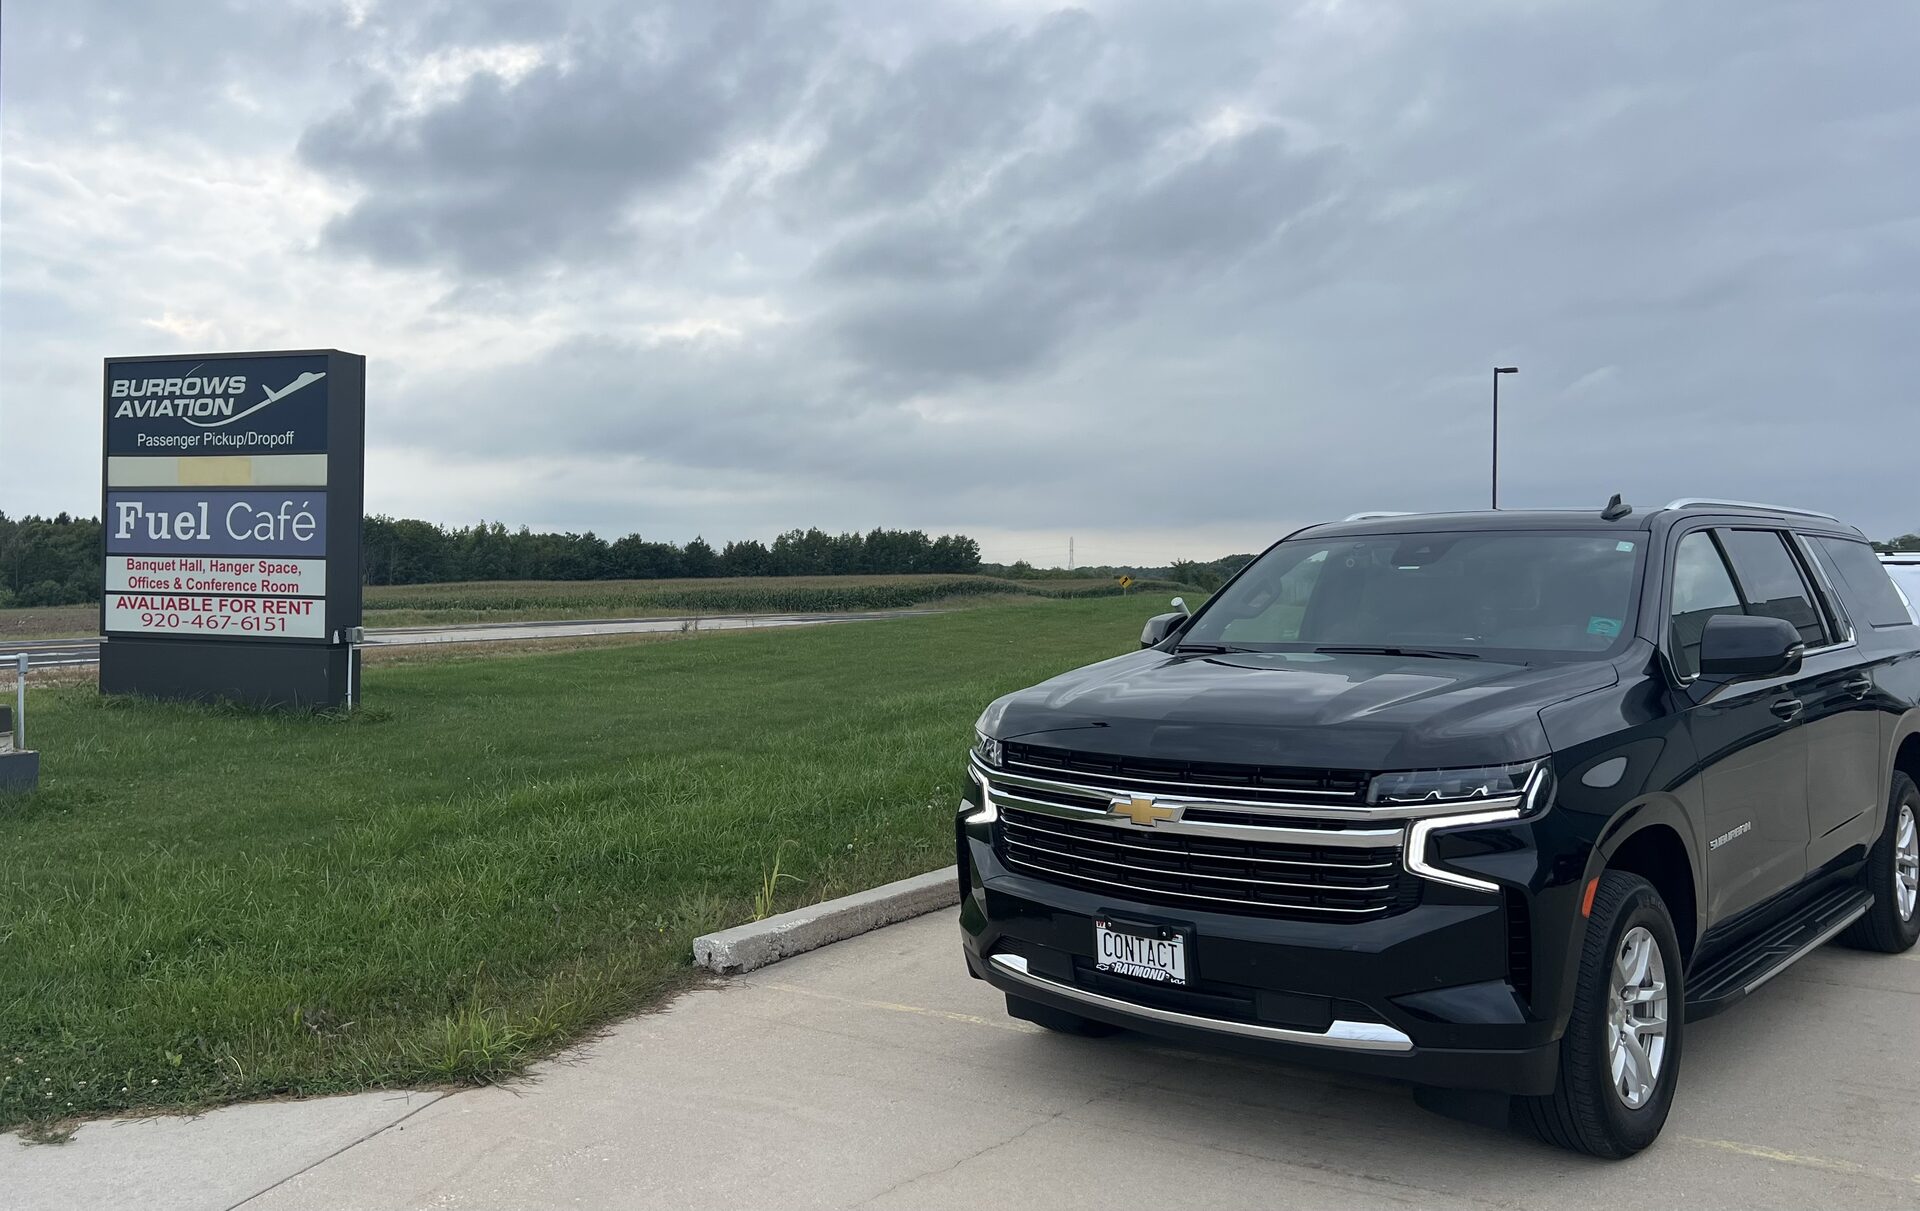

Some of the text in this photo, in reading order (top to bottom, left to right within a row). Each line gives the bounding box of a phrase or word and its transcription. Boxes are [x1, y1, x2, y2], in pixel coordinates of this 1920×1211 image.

[111, 375, 247, 397] BURROWS
[114, 398, 235, 418] AVIATION
[137, 431, 295, 450] Passenger Pickup/Dropoff
[115, 500, 317, 542] Fuel Café
[126, 558, 302, 576] Banquet Hall, Hanger Space,
[128, 576, 299, 593] Offices & Conference Room
[116, 596, 314, 615] AVALIABLE FOR RENT
[141, 613, 286, 632] 920-467-6151
[1103, 932, 1178, 970] CONTACT
[1113, 962, 1166, 981] RAYMOND
